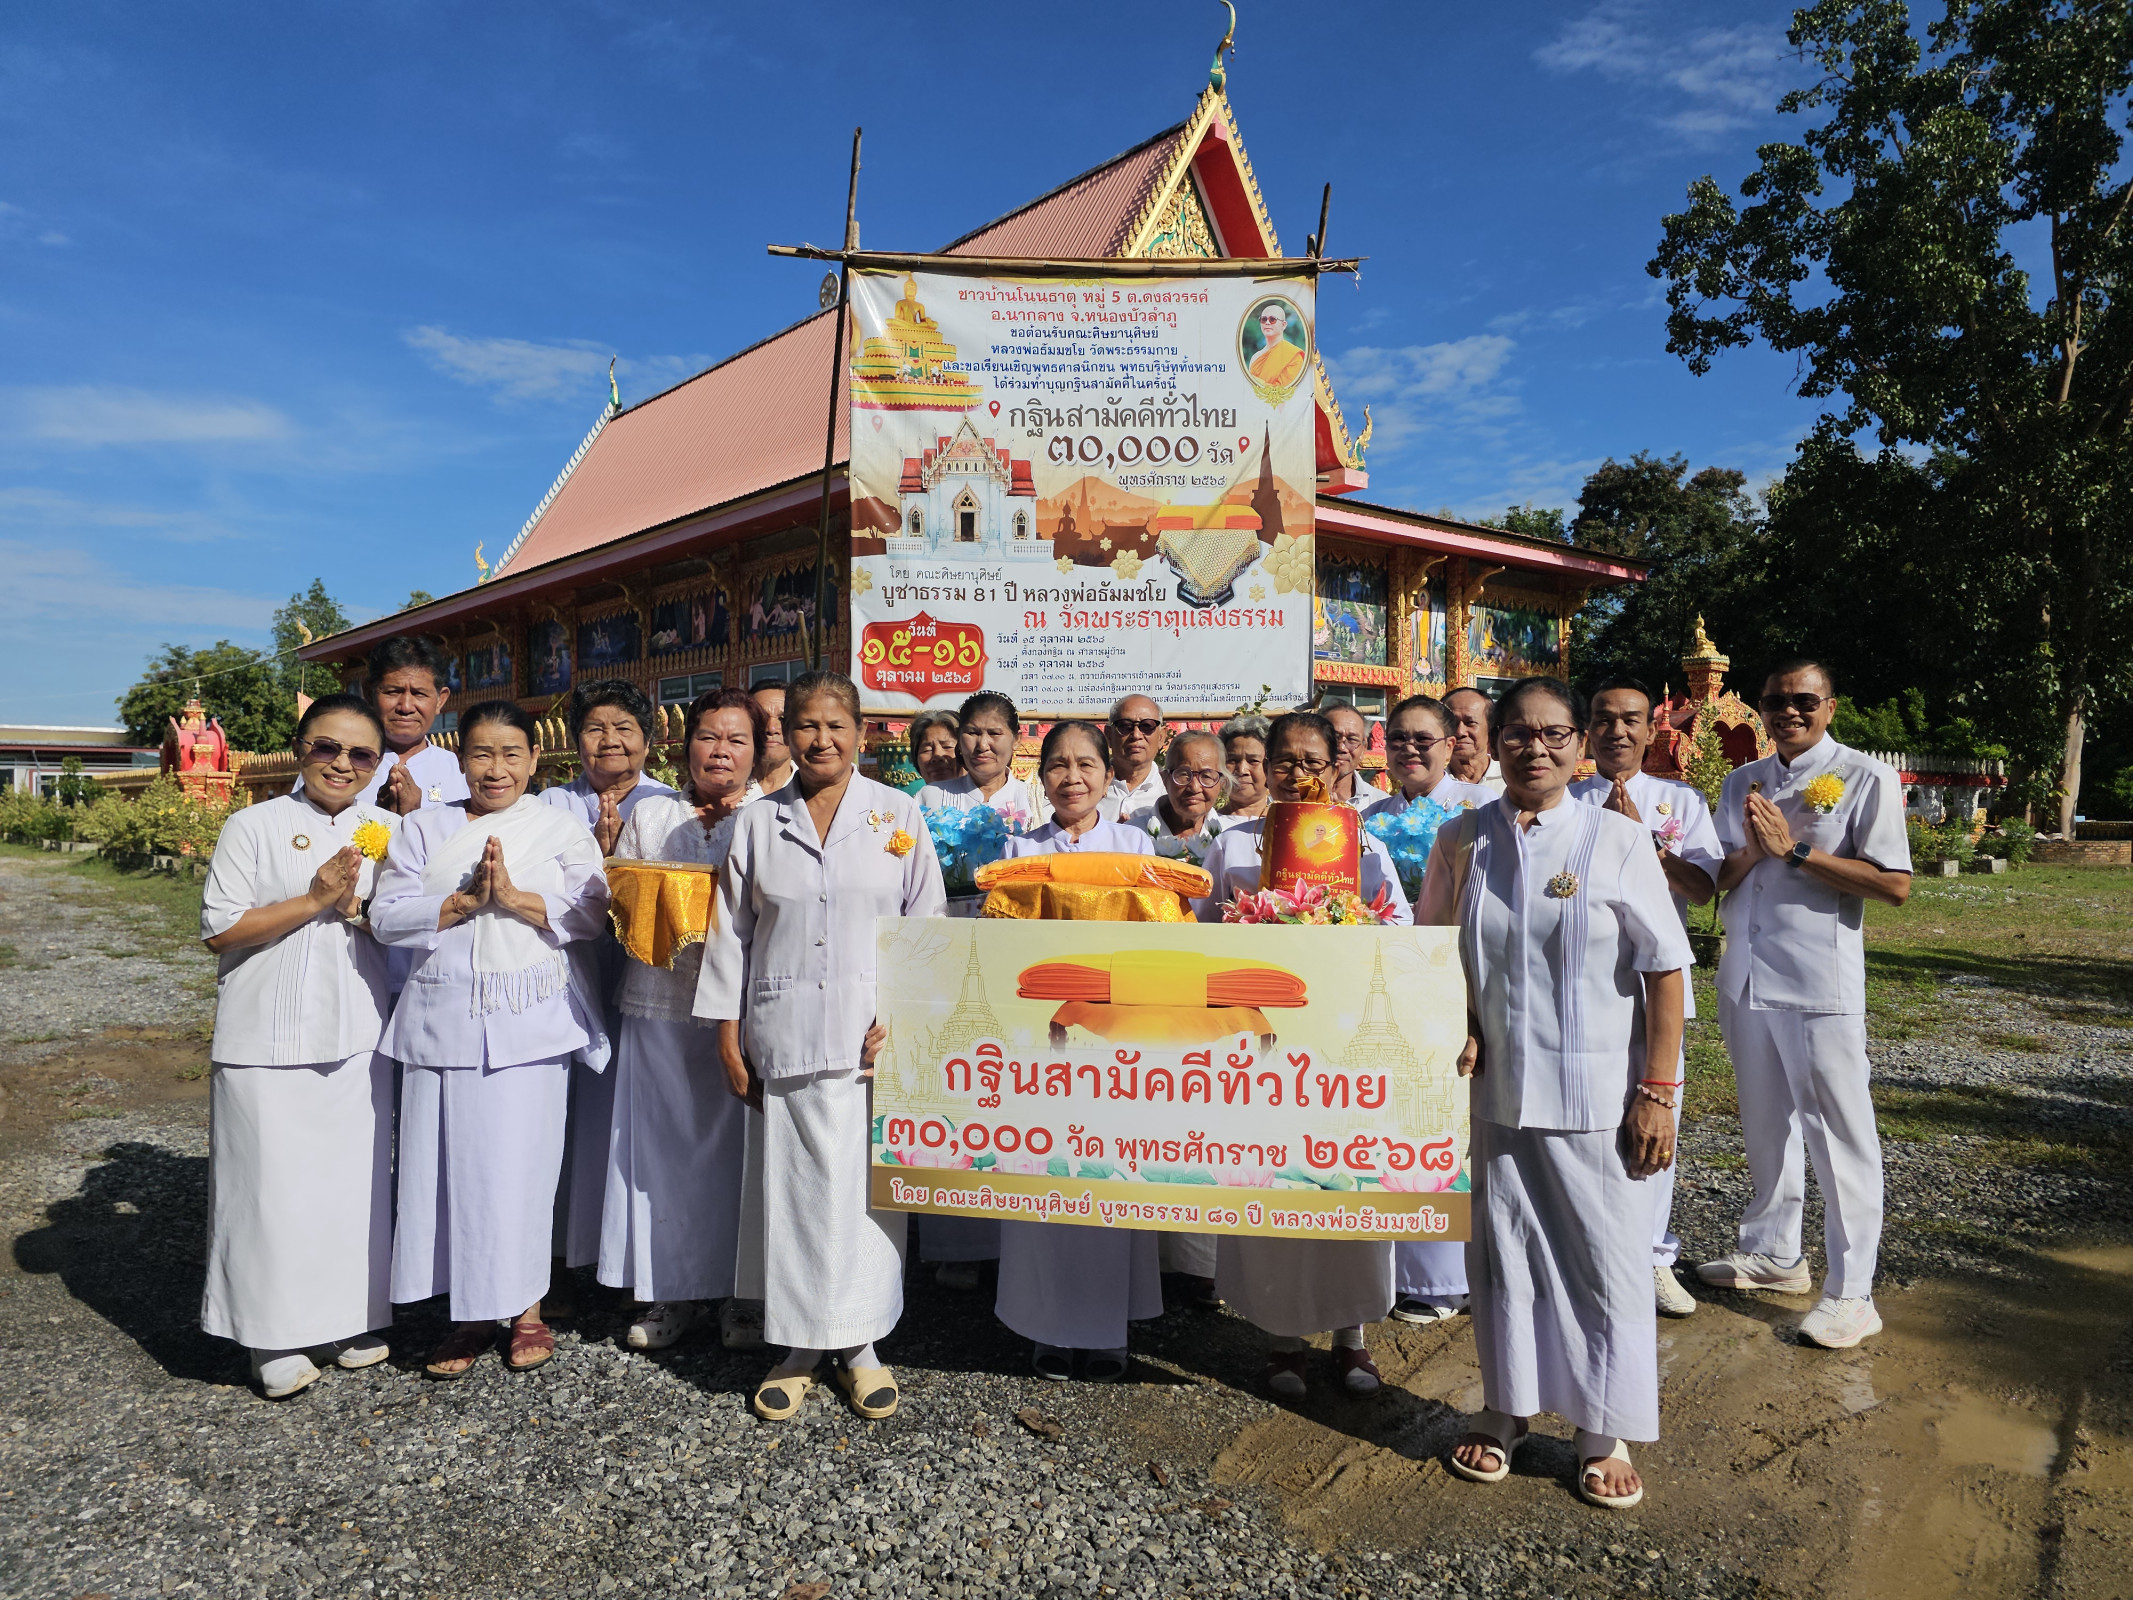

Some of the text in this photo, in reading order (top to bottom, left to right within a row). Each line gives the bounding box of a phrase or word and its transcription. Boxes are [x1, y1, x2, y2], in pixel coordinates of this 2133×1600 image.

[959, 285, 1208, 308] ชาวบ้านโนนธาตุ หมู่ 5 ต.ดงสวรรค์
[991, 307, 1177, 328] อ.นากลาง จ.หนองบัวลำภู
[1090, 344, 1178, 356] วัดพระธรรมกาย
[1009, 391, 1236, 437] กฐินสามัคคีทั่วไทย
[1049, 435, 1234, 469] ๓๐,๐๐๐ วัด
[1118, 472, 1226, 492] พุทธศักราช ๒๕๖๘
[889, 565, 1002, 584] โดย คณะศิษยานุศิษย์
[882, 579, 1166, 607] บูชาธรรม 81 ปี หลวงพ่อธัมมชโย
[908, 616, 936, 636] วันที่
[1024, 603, 1284, 637] ณ วัดพระธาตุแสงธรรม
[863, 630, 981, 666] ๑๕-๑๖
[997, 630, 1018, 643] วันที่
[1040, 634, 1073, 647] ตุลาคม
[997, 655, 1018, 668] วันที่
[1039, 659, 1073, 672] ตุลาคม
[876, 669, 971, 688] ตุลาคม ๒๕๖๘
[945, 1038, 1386, 1109] กฐินสามัคคีทั่วไทย
[888, 1117, 1454, 1172] ๓๐,๐๐๐ วัด พุทธศักราช ๒๕๖๘
[893, 1181, 1448, 1230] โดย คณะศิษยานุศิษย์ บูชาธรรม ๘๑ ปี หลวงพ่อธัมมชโย
